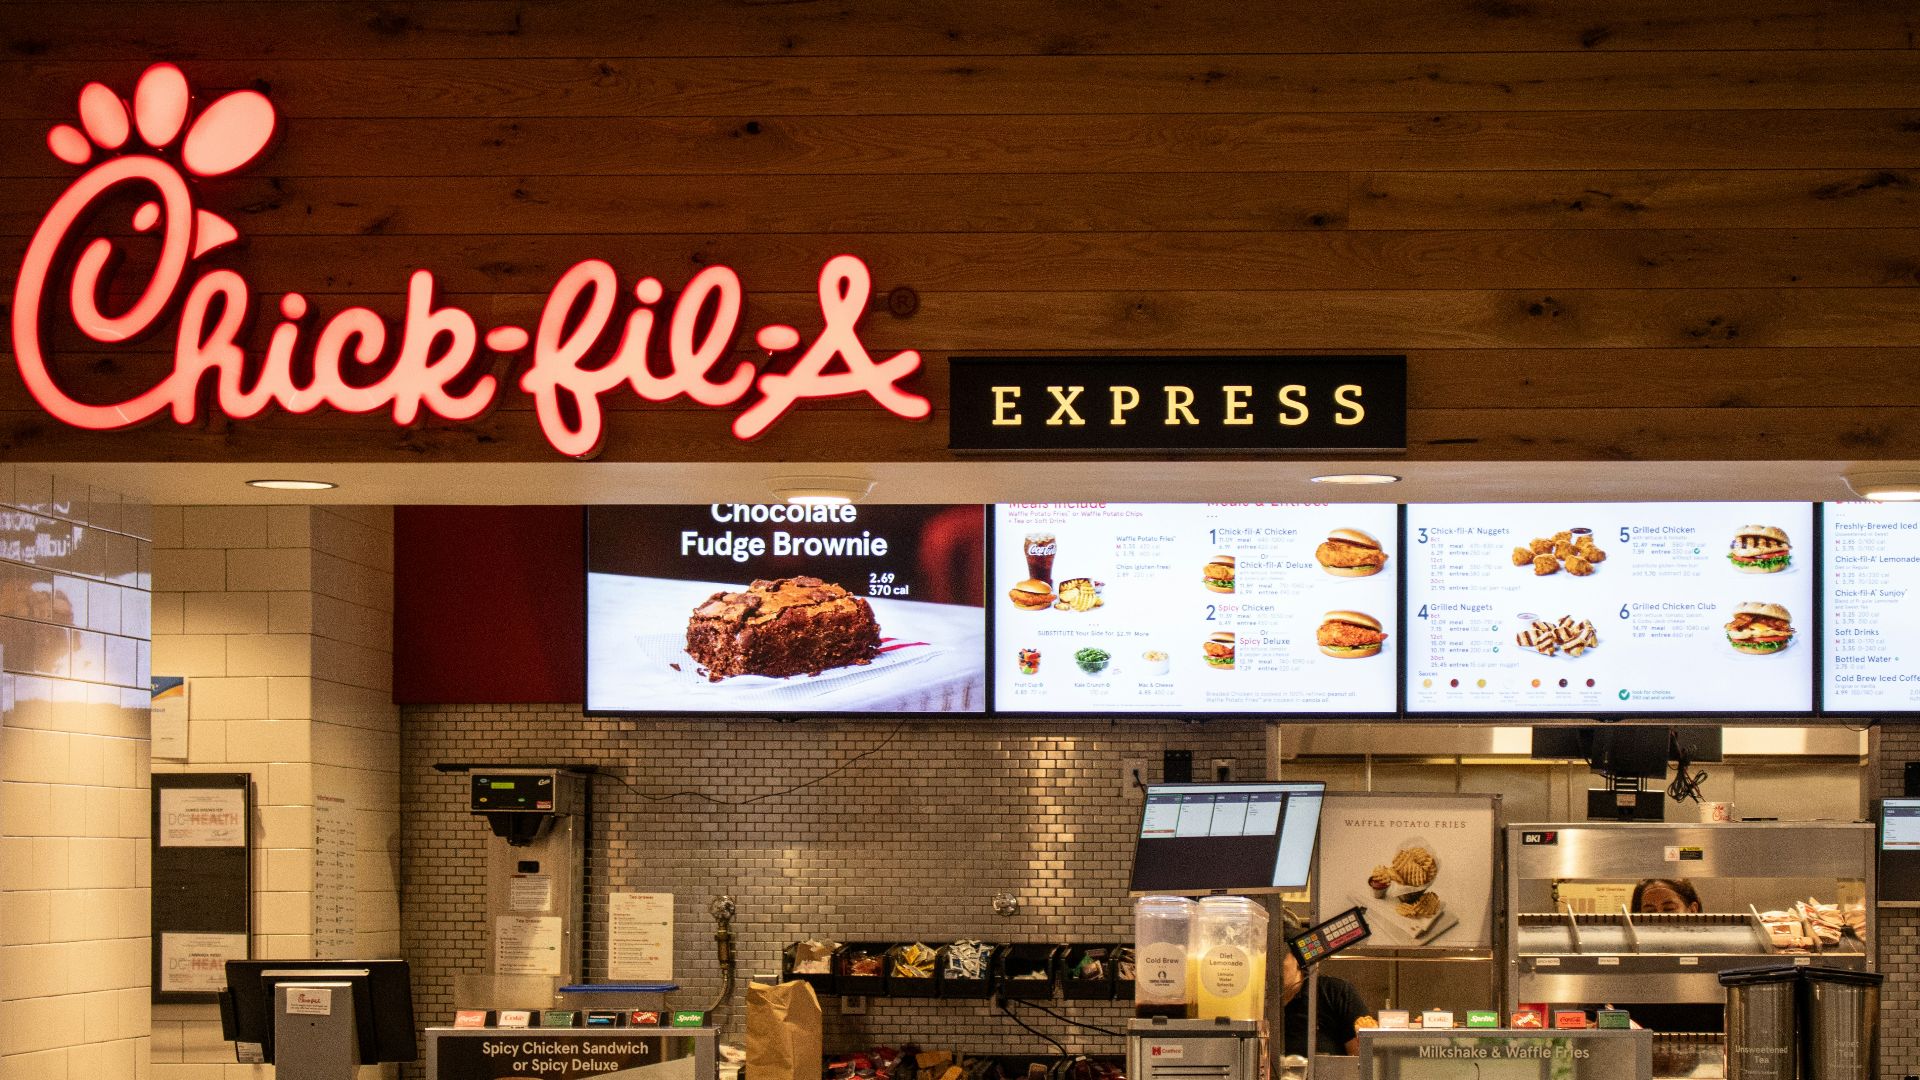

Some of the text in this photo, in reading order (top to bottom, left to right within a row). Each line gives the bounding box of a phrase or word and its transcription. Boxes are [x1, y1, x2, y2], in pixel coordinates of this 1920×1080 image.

[12, 150, 932, 457] Chick-fil-A
[992, 384, 1366, 426] EXPRESS
[711, 503, 857, 523] Chocolate
[1126, 510, 1143, 518] Chips
[1264, 527, 1297, 535] Chicken
[1632, 526, 1696, 534] Grilled Chicken
[1835, 522, 1918, 531] Freshly-Brewed Iced
[1417, 527, 1429, 544] 3
[1477, 527, 1510, 536] Nuggets
[1619, 526, 1630, 543] 5
[1209, 528, 1216, 545] 1
[681, 531, 888, 563] Fudge Brownie
[1879, 555, 1920, 563] Lemonade
[1286, 561, 1313, 569] Deluxe
[869, 573, 895, 584] 2.69
[869, 585, 909, 596] 370 cal
[1879, 589, 1906, 598] Sunjoy
[1218, 604, 1239, 613] Spicy
[1417, 604, 1429, 620] 4
[1430, 603, 1493, 612] Grilled Nuggets
[1619, 603, 1630, 620] 6
[1205, 604, 1216, 621] 2
[1835, 628, 1880, 636] Soft Drinks
[1239, 638, 1261, 646] Spicy
[1835, 655, 1892, 663] Bottled Water
[1835, 674, 1854, 682] Cold
[1856, 674, 1877, 682] Brew
[1879, 674, 1897, 682] Iced
[190, 812, 239, 826] HEALTH
[1344, 819, 1467, 829] WAFFLE POTATO FRIES
[1525, 834, 1541, 843] BKI
[191, 957, 225, 971] HEAL
[1209, 959, 1243, 967] Lemonade
[676, 1014, 702, 1022] Sprite
[1470, 1014, 1495, 1023] Sprite
[482, 1041, 649, 1057] Spicy Chicken Sandwich
[1419, 1045, 1590, 1059] Milkshake & Waffle Fries
[1735, 1045, 1788, 1054] Unsweetened
[1754, 1055, 1770, 1065] Tea
[513, 1058, 619, 1074] or Spicy Deluxe
